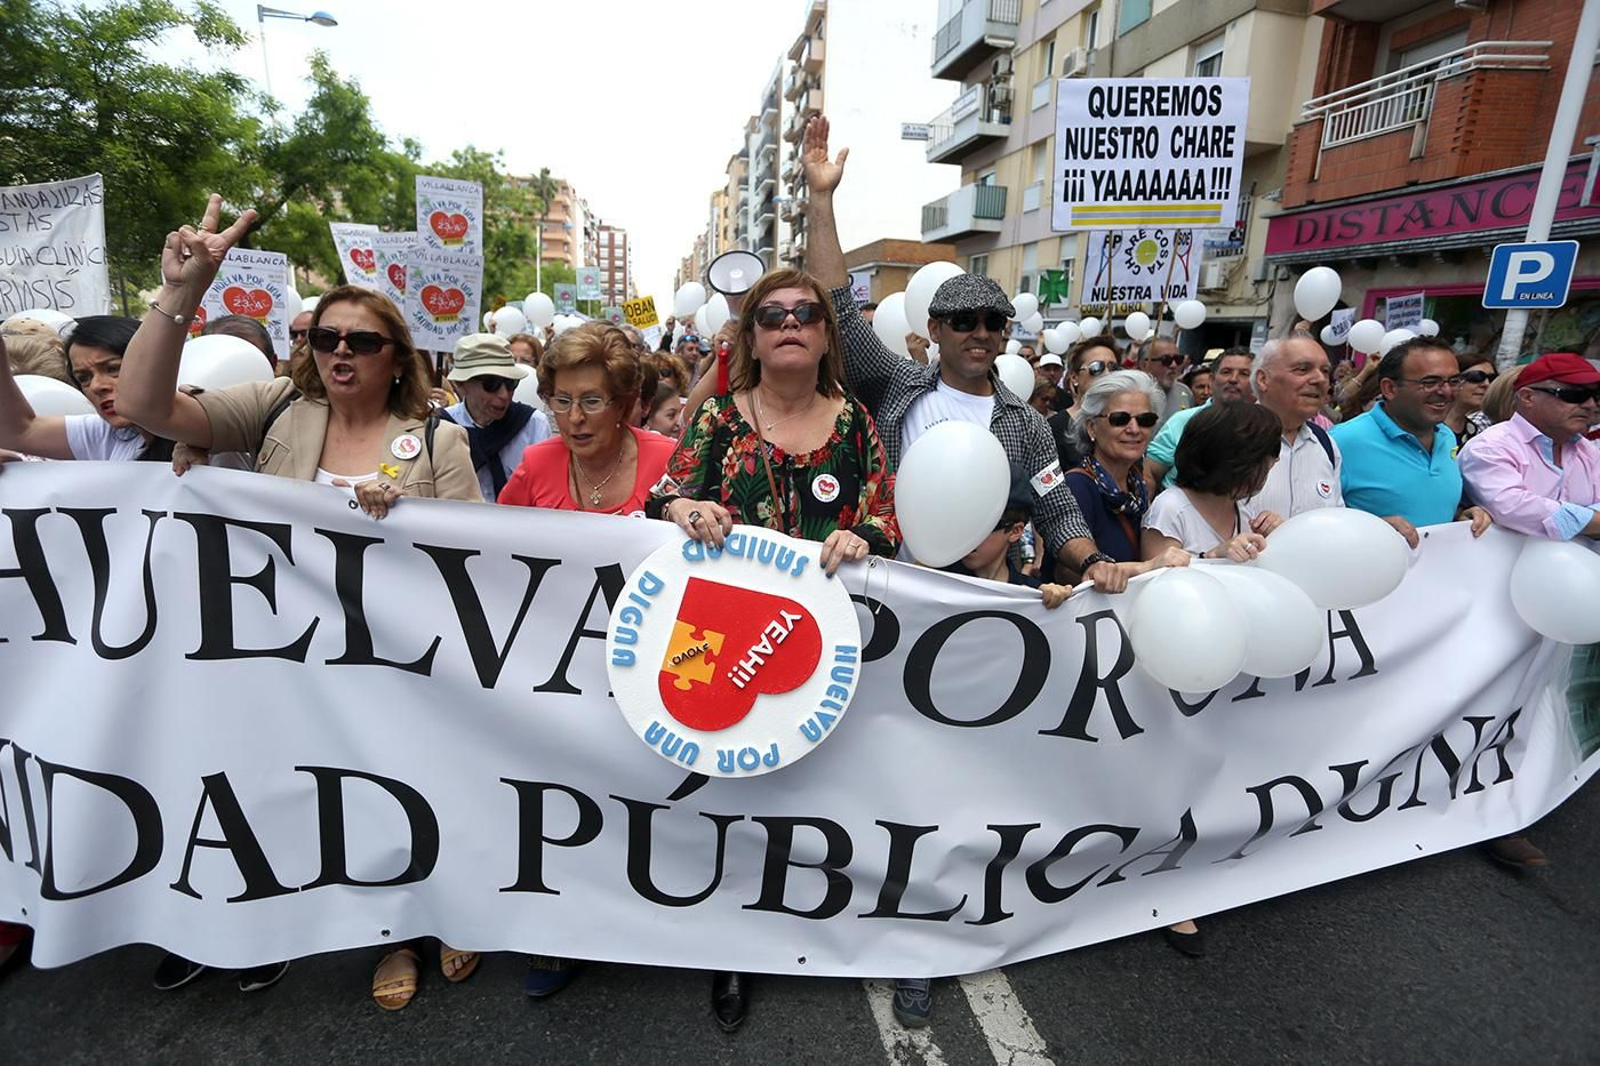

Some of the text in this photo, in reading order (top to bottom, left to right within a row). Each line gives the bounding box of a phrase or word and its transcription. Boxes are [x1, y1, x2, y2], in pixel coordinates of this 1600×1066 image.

[1088, 84, 1223, 119] QUEREMOS
[1065, 125, 1237, 160] NUESTRO CHARE
[1091, 285, 1152, 302] NUESTRA
[1501, 250, 1555, 300] P
[1519, 292, 1531, 300] EN
[612, 570, 666, 667] DIGNA
[727, 609, 802, 689] YEAH!!
[644, 644, 857, 773] HUELVA POR UNA
[499, 771, 1198, 925] PÚBLICA
